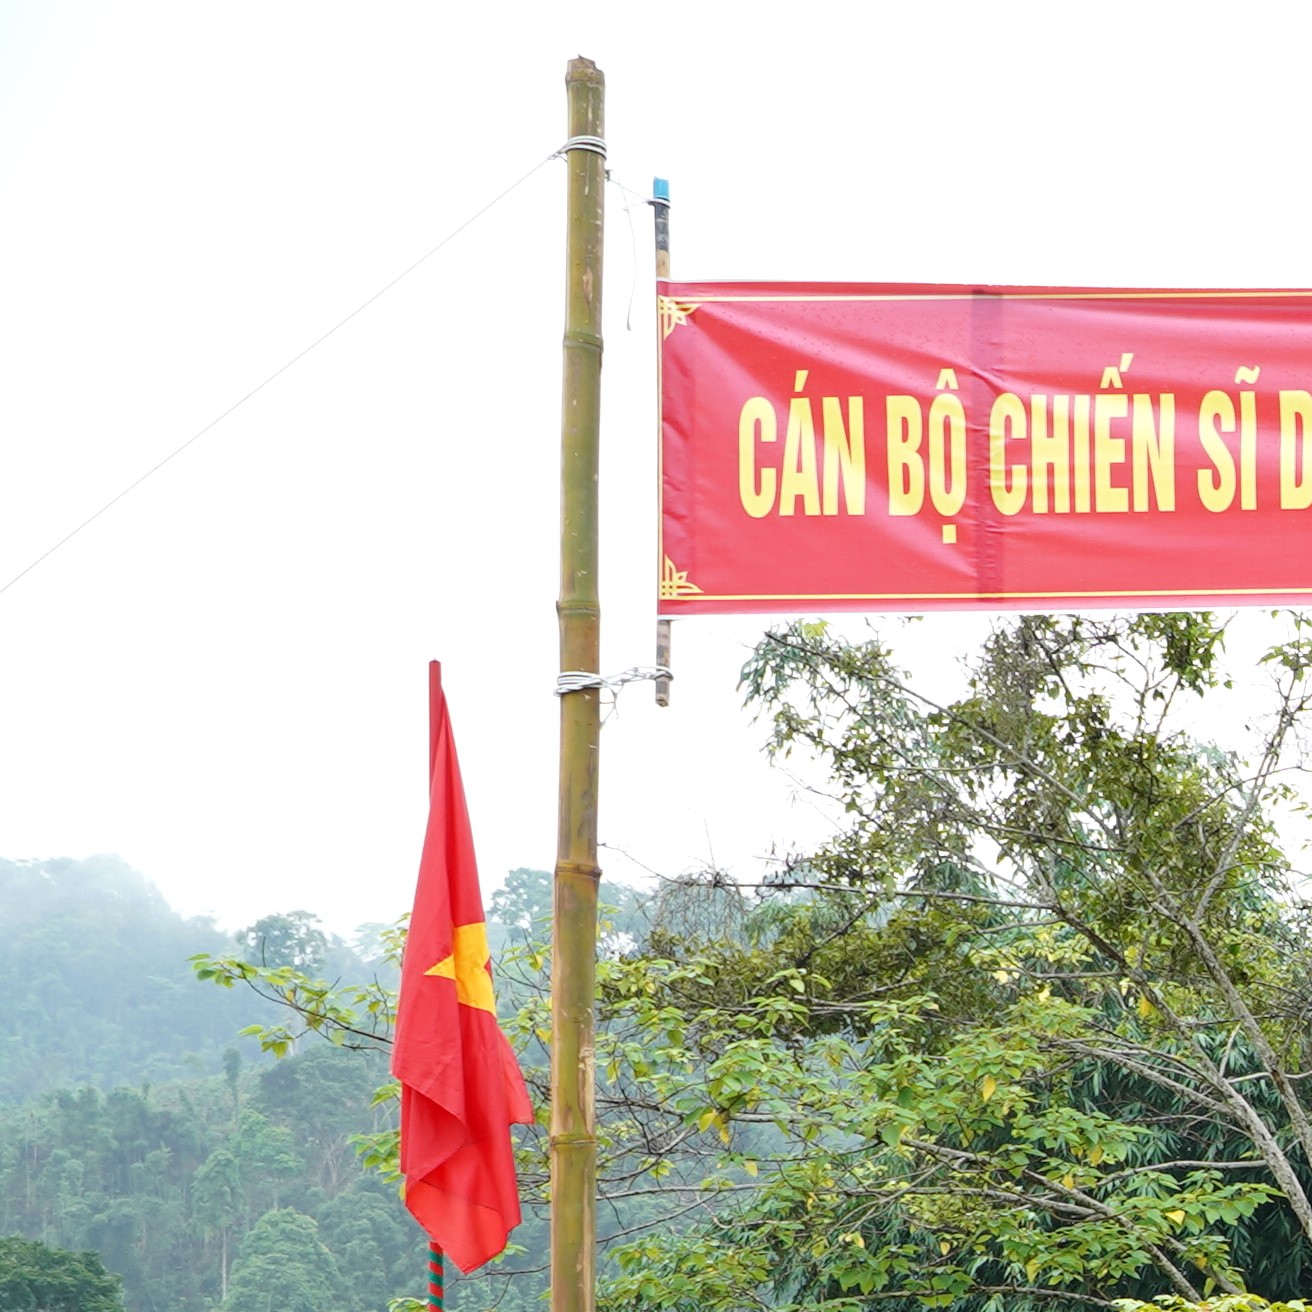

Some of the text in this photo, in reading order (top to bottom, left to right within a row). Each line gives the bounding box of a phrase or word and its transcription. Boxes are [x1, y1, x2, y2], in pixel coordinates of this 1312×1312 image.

[739, 370, 866, 518] CÁN
[886, 368, 967, 545] BỘ
[988, 353, 1176, 515] CHIẾN
[1197, 365, 1258, 512] SĨ
